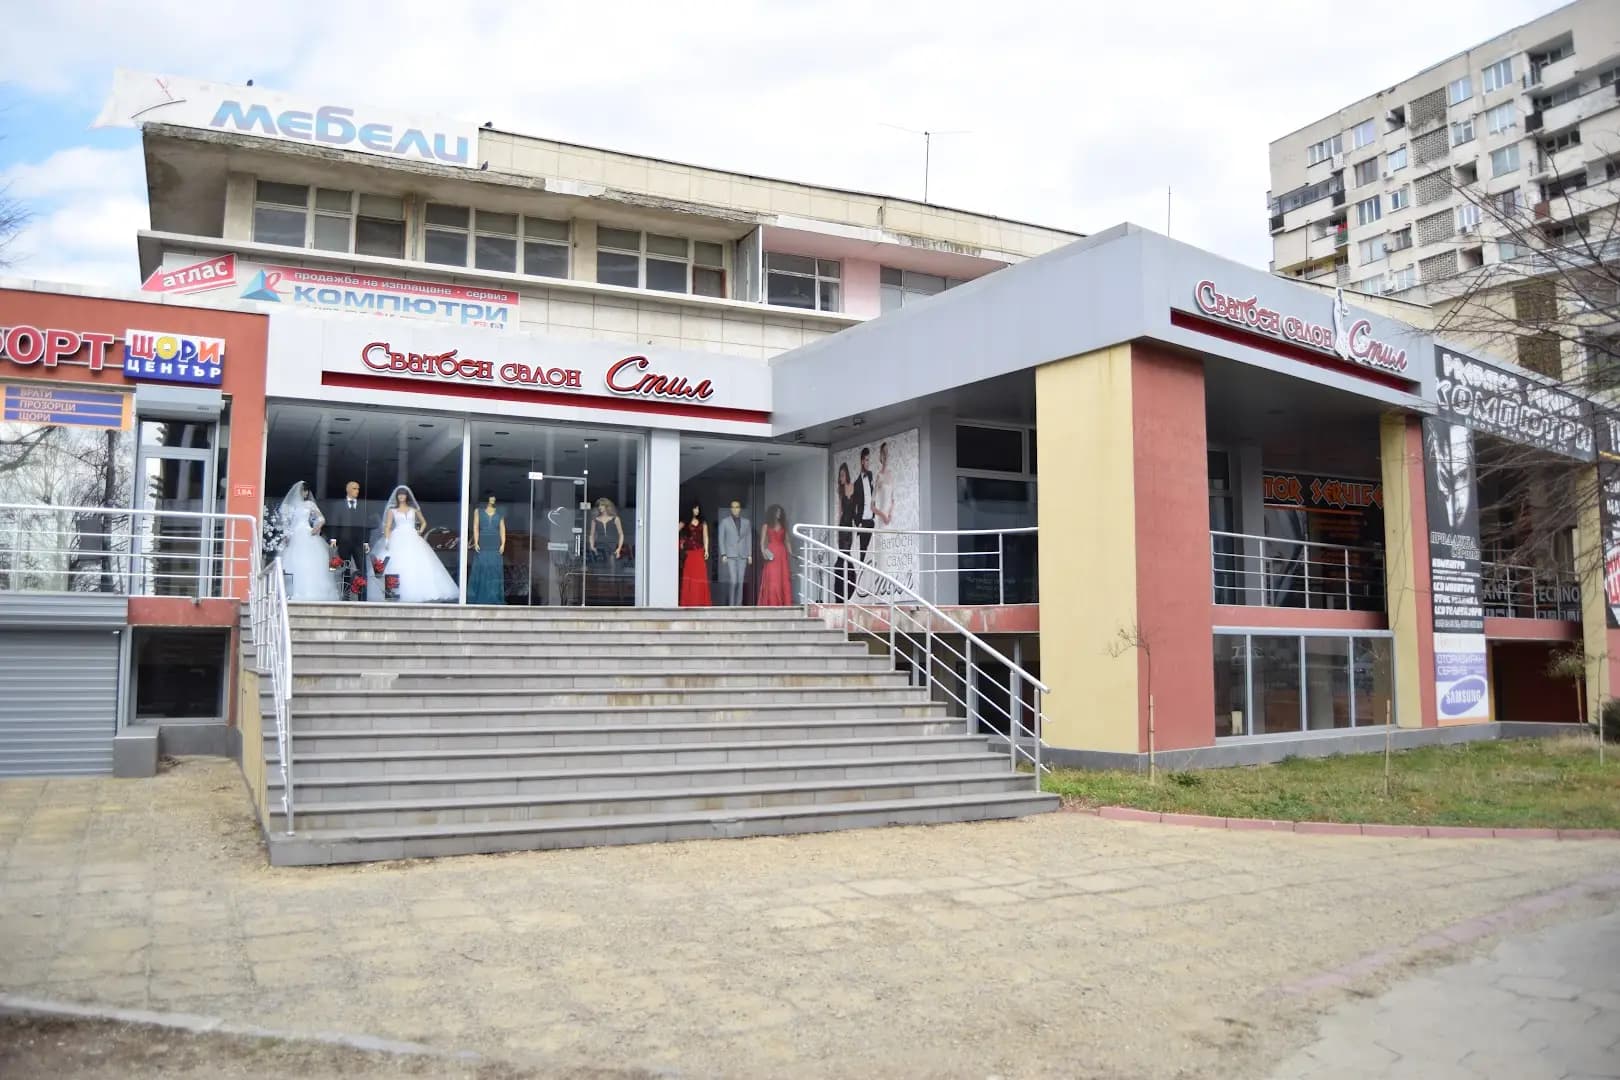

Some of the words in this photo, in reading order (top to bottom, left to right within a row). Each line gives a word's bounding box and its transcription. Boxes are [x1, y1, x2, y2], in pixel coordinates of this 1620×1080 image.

[163, 259, 228, 287] атлас
[294, 272, 361, 287] продажба
[363, 278, 378, 288] на
[381, 281, 451, 295] изплащане
[466, 289, 508, 302] сервиз
[1195, 280, 1281, 333] Сватбен
[1283, 316, 1335, 349] салон
[0, 325, 114, 370] ОРТ
[127, 359, 221, 378] ЦЕНТЪР
[362, 342, 493, 380] Сватбен
[500, 362, 582, 388] салон
[605, 355, 714, 400] Стил
[19, 400, 76, 412] ПРОЗОРЦИ
[1446, 689, 1481, 704] SAMSUNG
